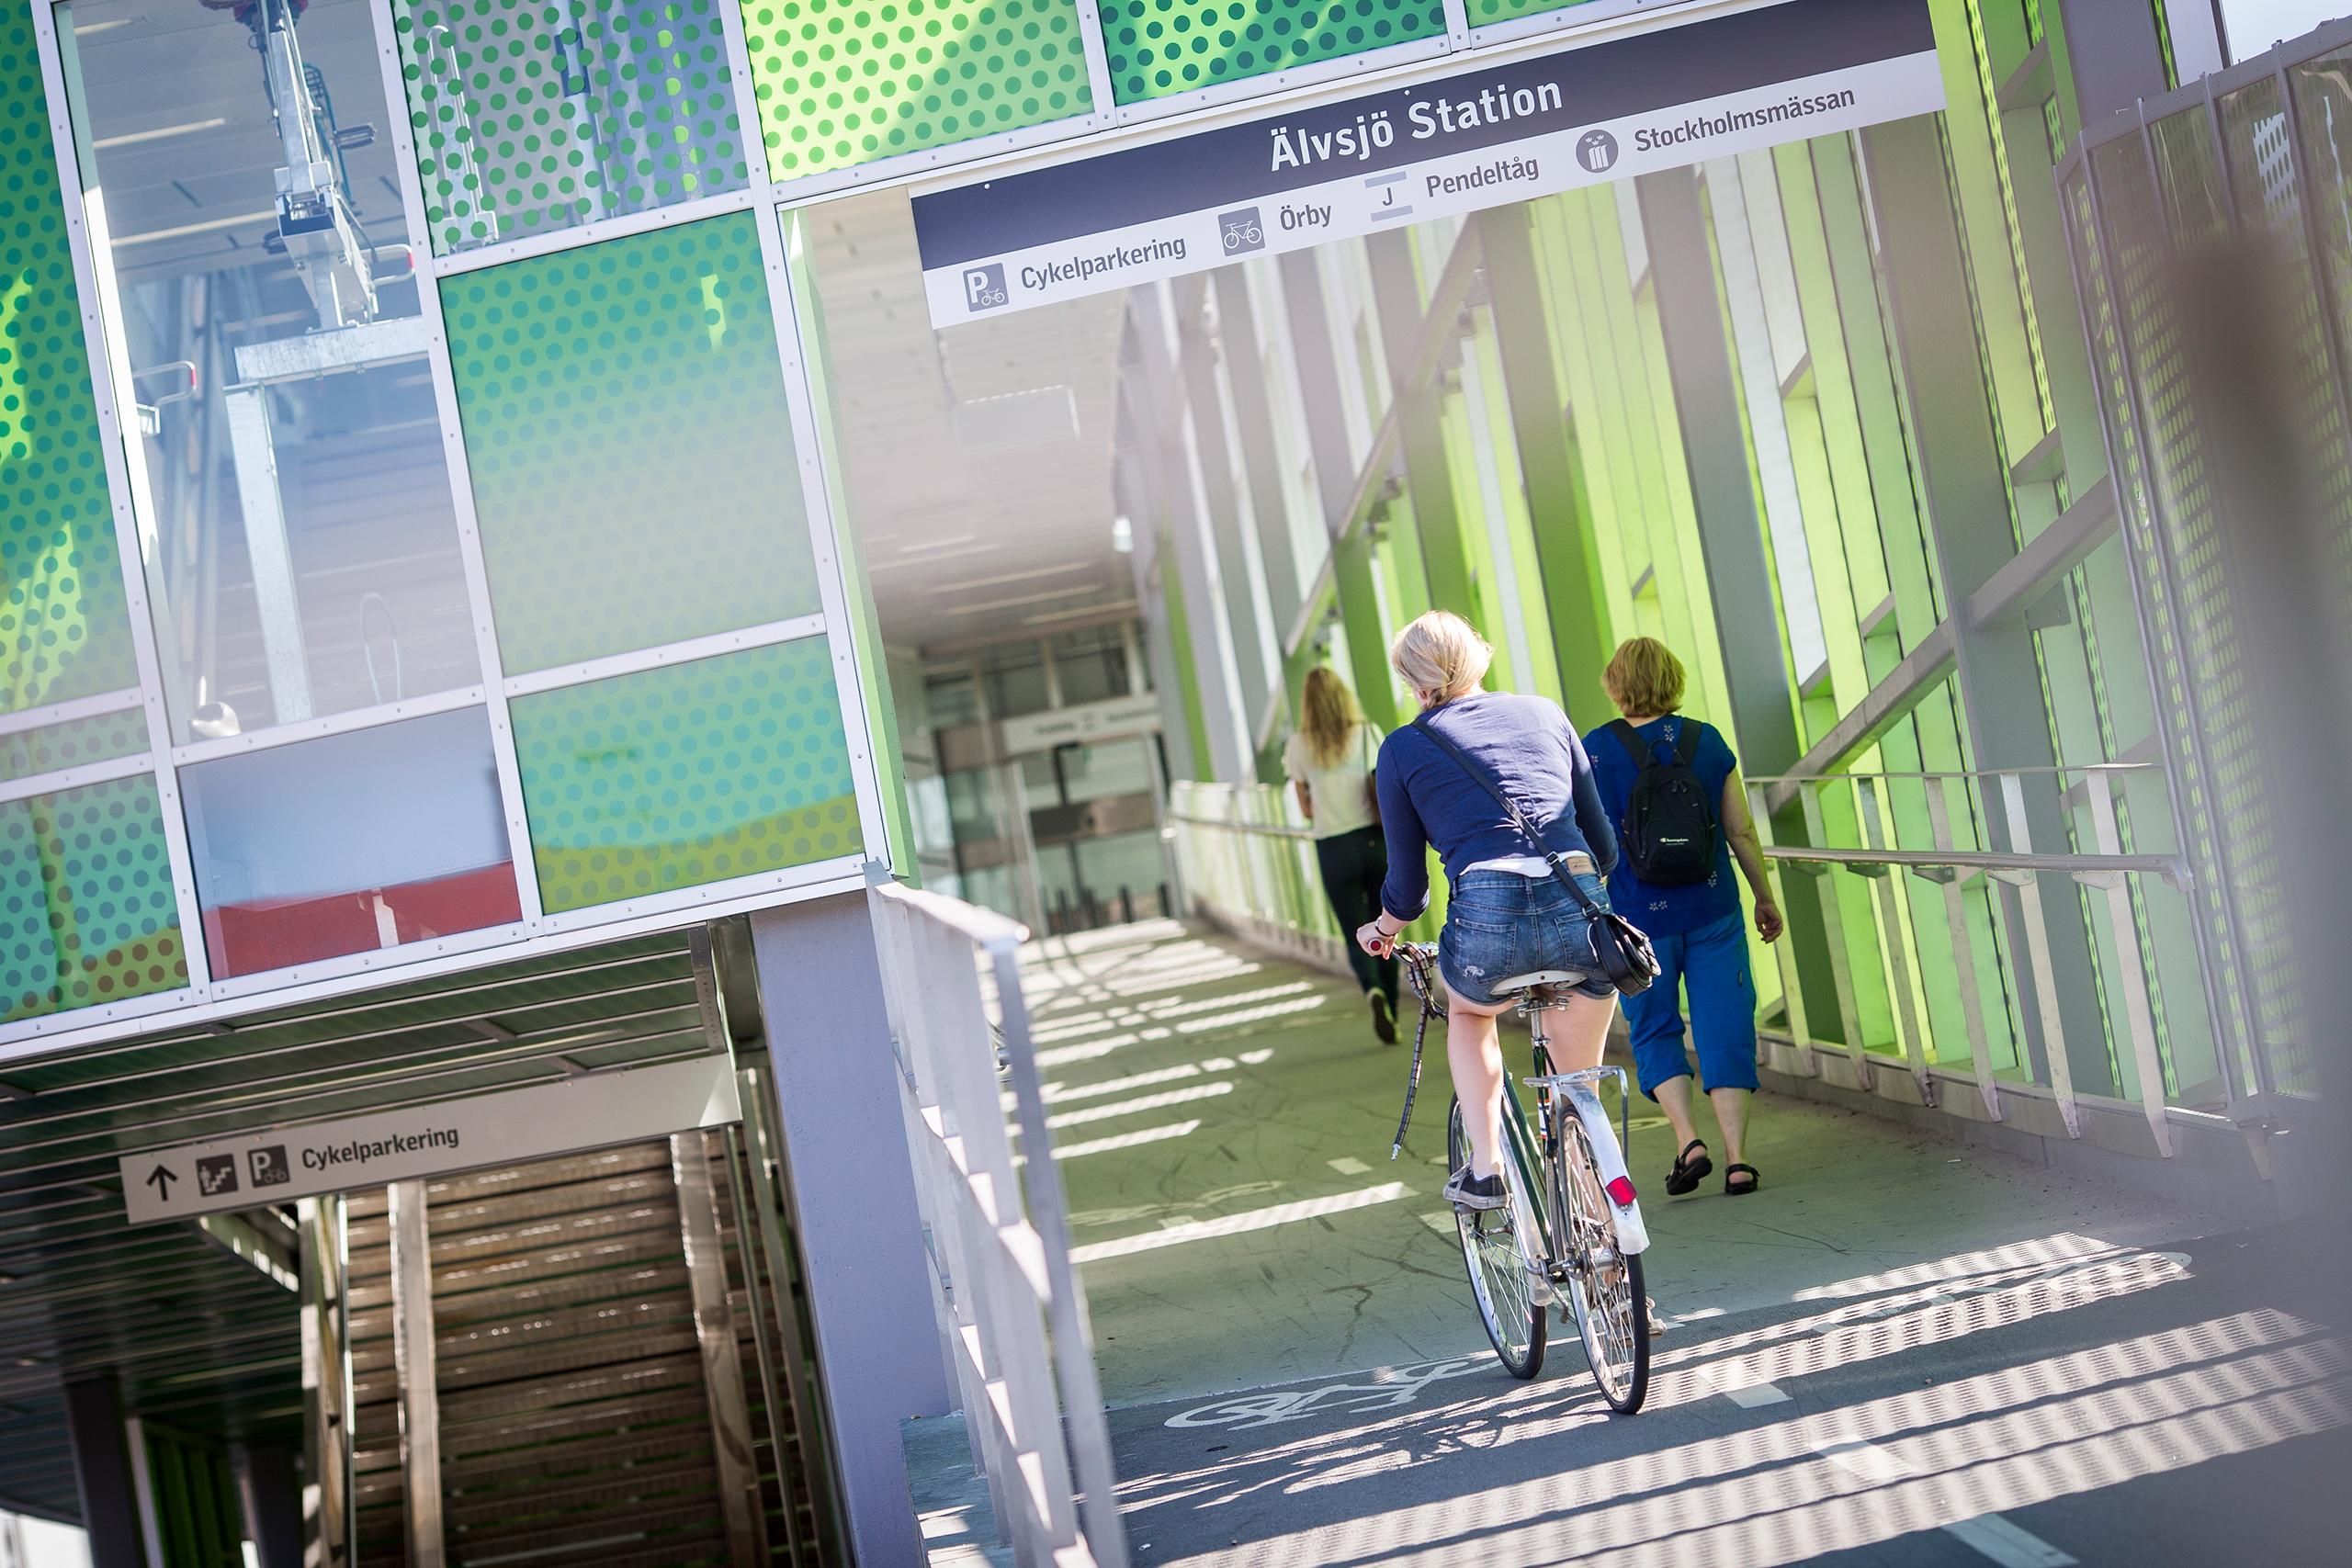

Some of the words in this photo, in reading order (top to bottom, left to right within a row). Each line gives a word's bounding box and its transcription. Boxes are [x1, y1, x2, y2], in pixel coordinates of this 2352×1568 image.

[1272, 109, 1394, 172] Älvsjö
[1408, 82, 1563, 140] Station
[967, 271, 989, 303] P
[1021, 238, 1187, 291] Cykelparkering
[1280, 204, 1331, 231] Örby
[1382, 186, 1394, 207] J
[1426, 155, 1540, 198] Pendeltåg
[1634, 89, 1856, 152] Stockholmsmässan
[250, 1152, 272, 1180] P
[301, 1129, 459, 1171] Cykelparkering
